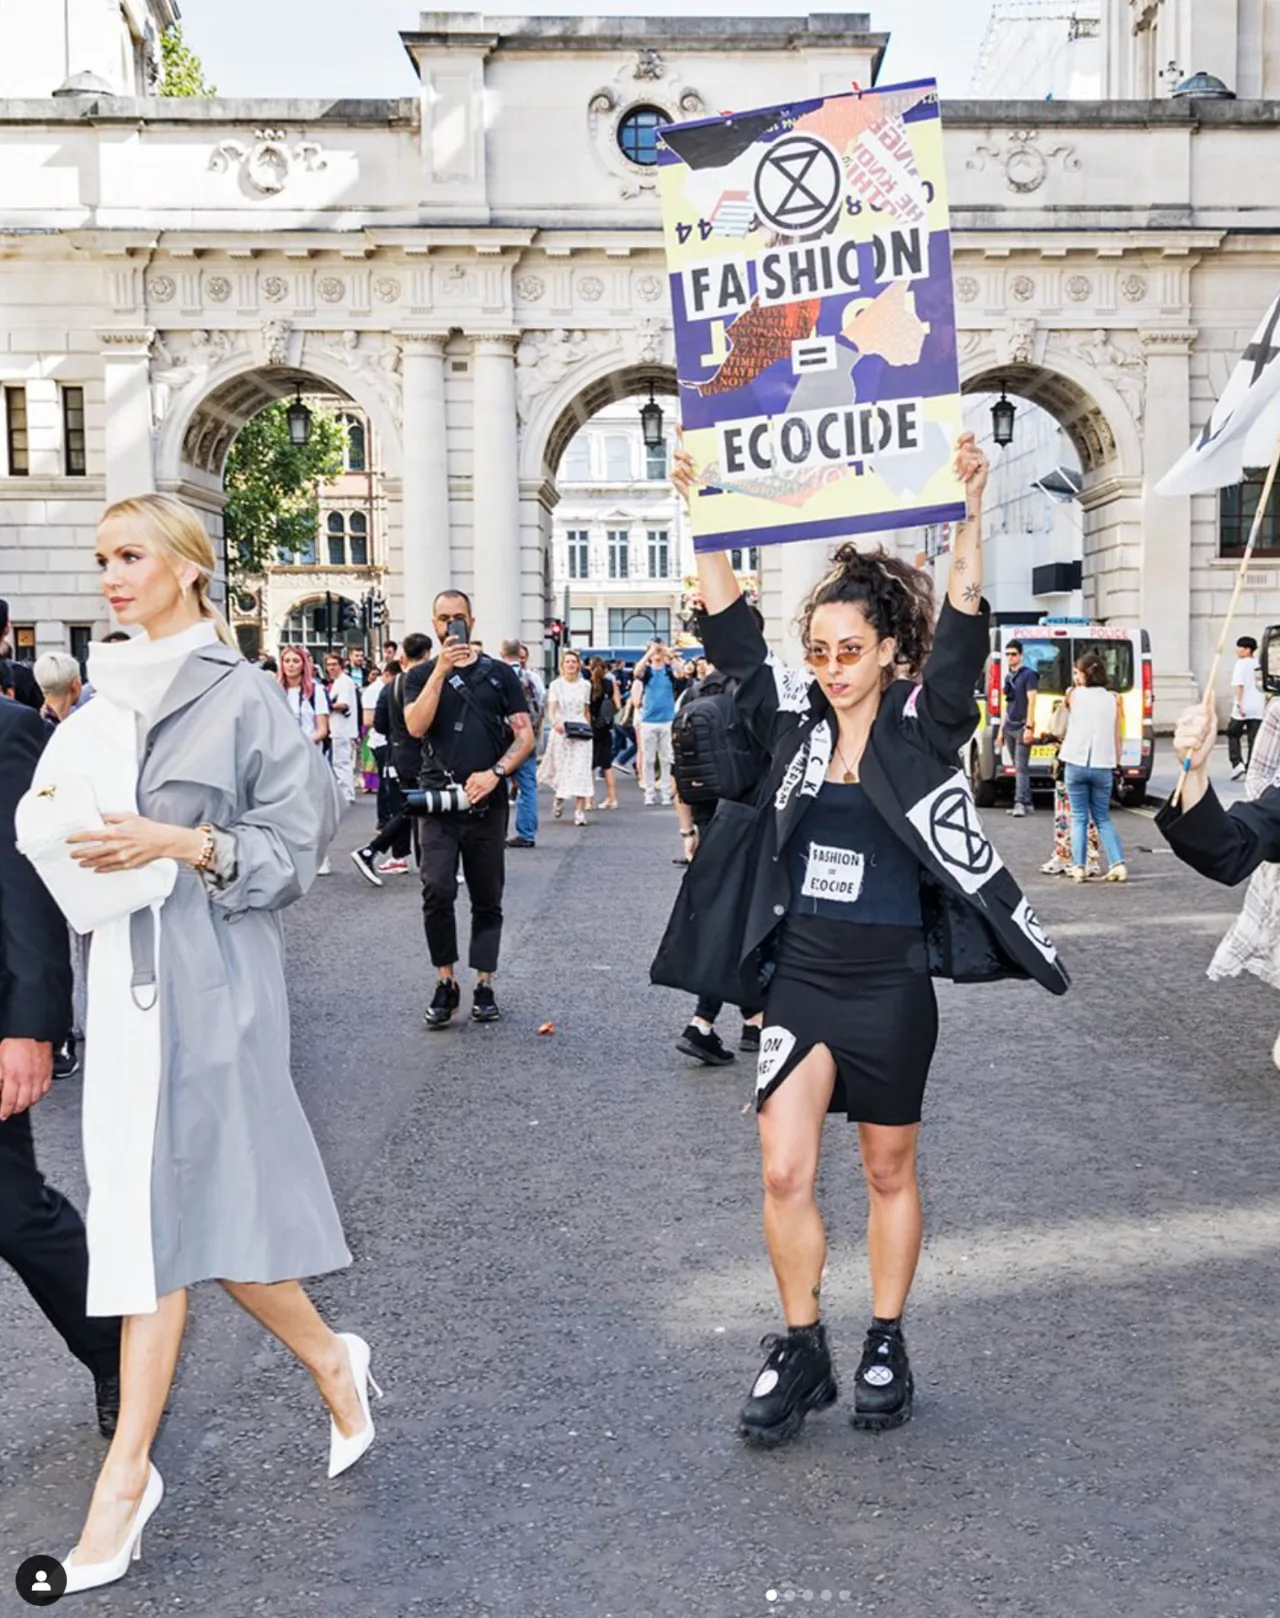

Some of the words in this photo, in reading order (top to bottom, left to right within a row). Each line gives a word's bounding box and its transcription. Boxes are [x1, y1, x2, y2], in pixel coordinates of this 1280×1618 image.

[692, 227, 922, 311] FASHION
[723, 402, 918, 474] ECOCIDE
[1090, 628, 1128, 638] POLICE
[812, 848, 860, 868] FASHION
[764, 1038, 783, 1053] ON
